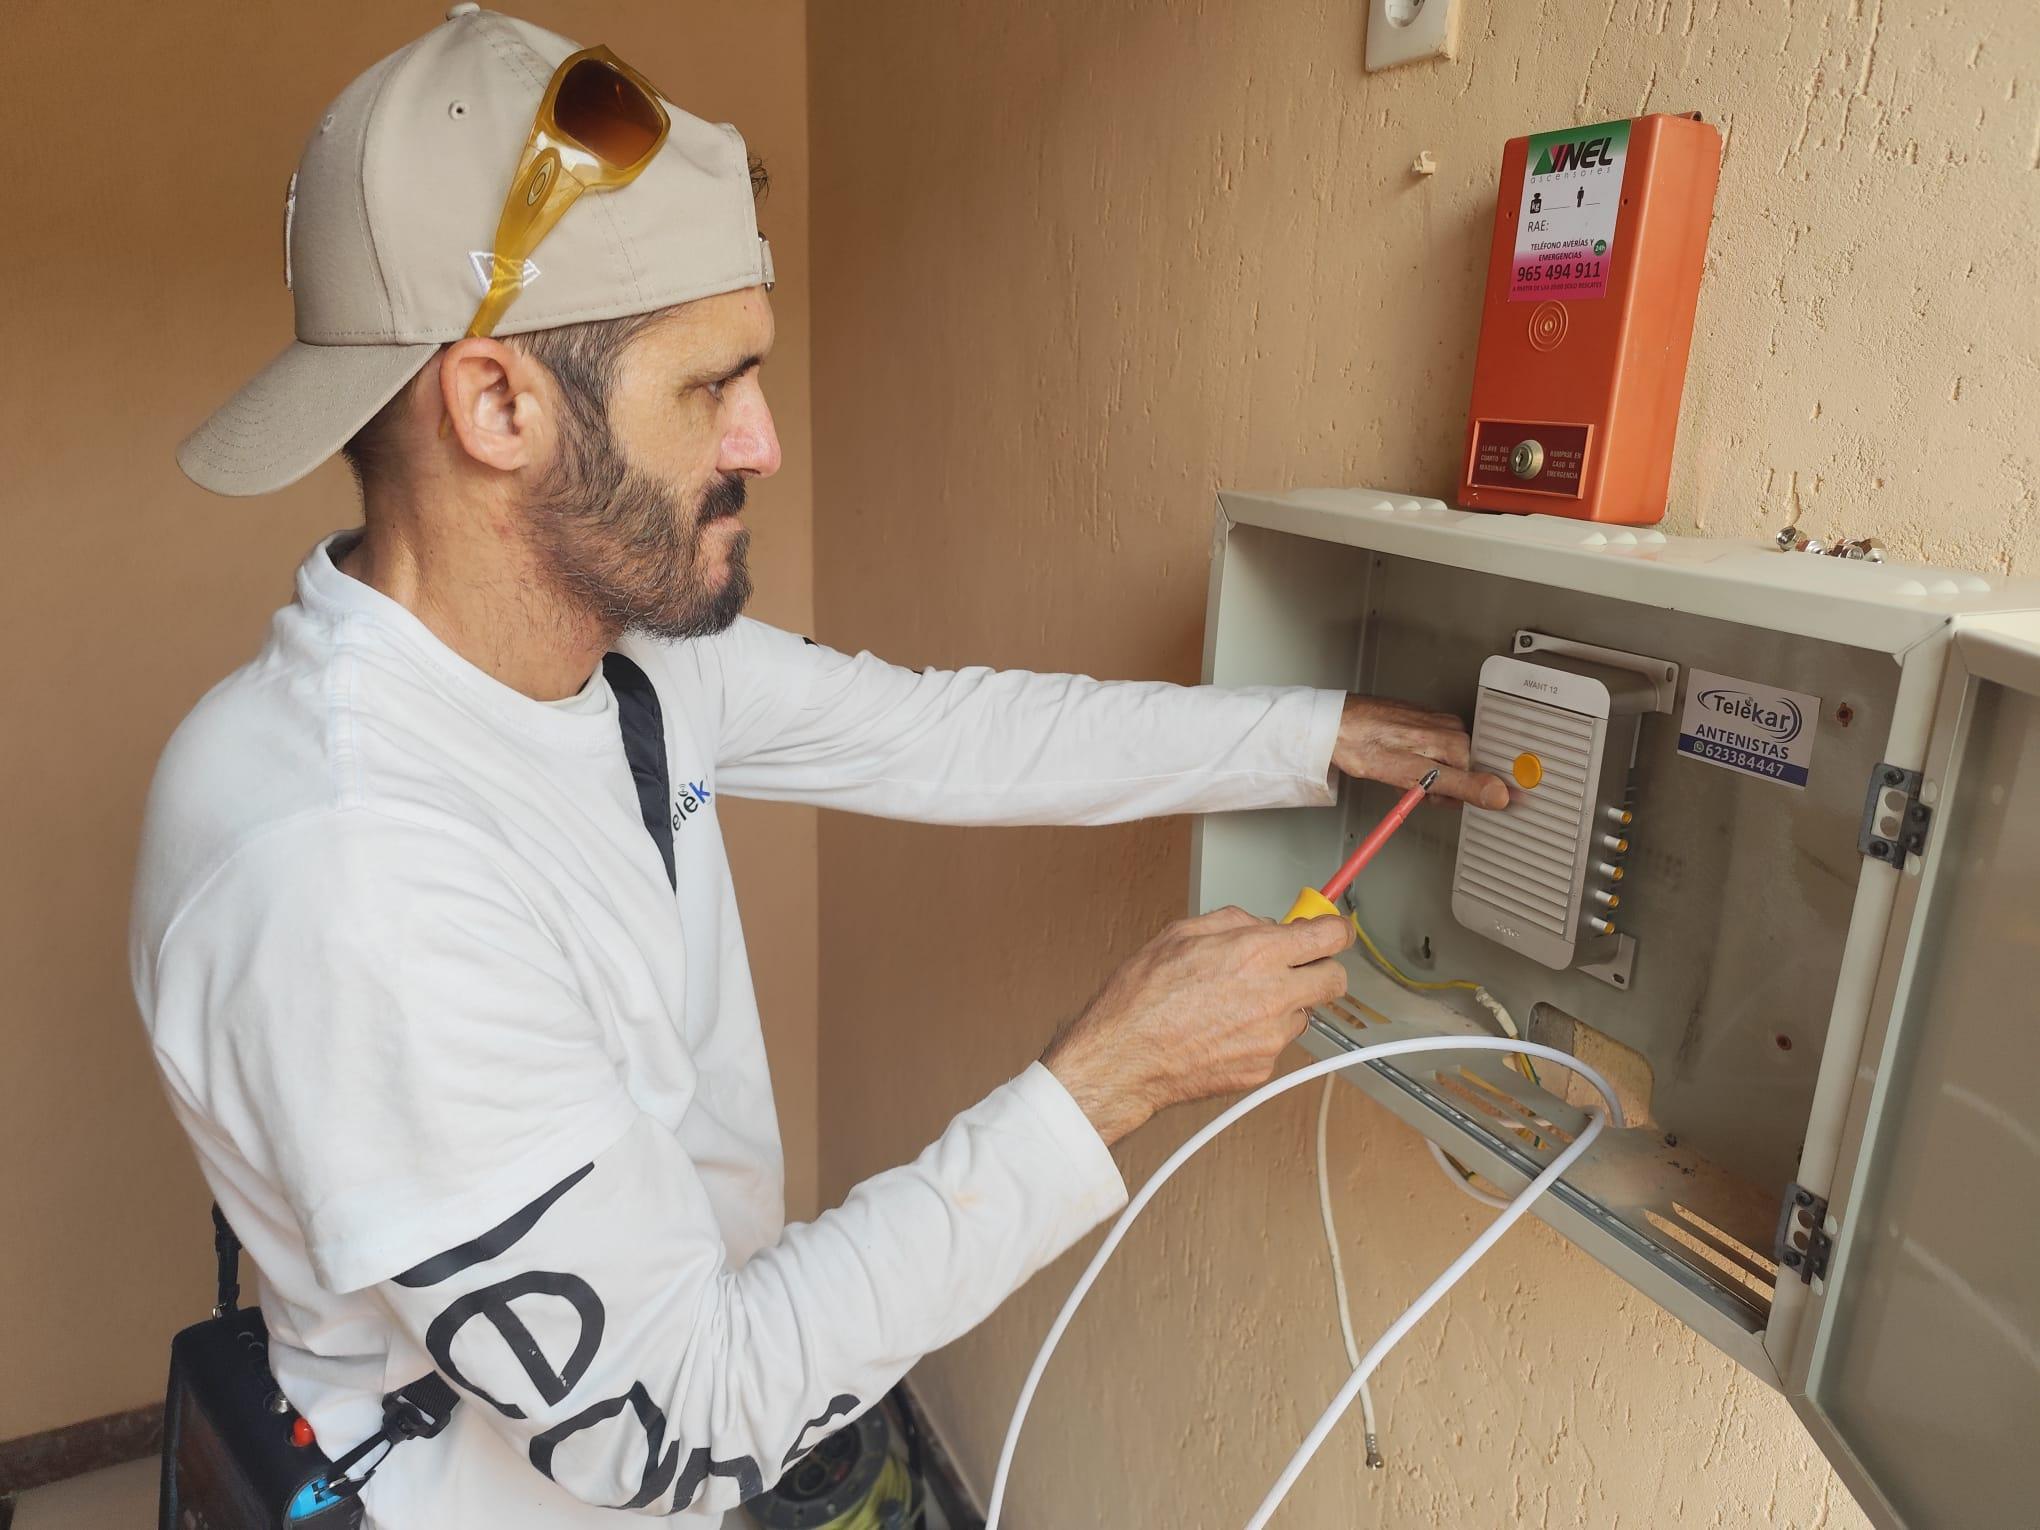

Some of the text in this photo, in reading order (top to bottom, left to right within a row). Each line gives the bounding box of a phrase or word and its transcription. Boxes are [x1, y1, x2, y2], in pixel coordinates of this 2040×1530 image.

[1530, 166, 1611, 184] ascensores
[1527, 219, 1550, 233] RAE:
[1531, 238, 1595, 251] TELÉFONO AVERÍAS Y
[1538, 251, 1582, 262] EMERGENCIAS
[1517, 261, 1601, 282] 965 494 911
[1522, 679, 1559, 695] AVANT 12
[1695, 723, 1790, 760] ANTENISTAS
[1705, 743, 1785, 778] 623384447
